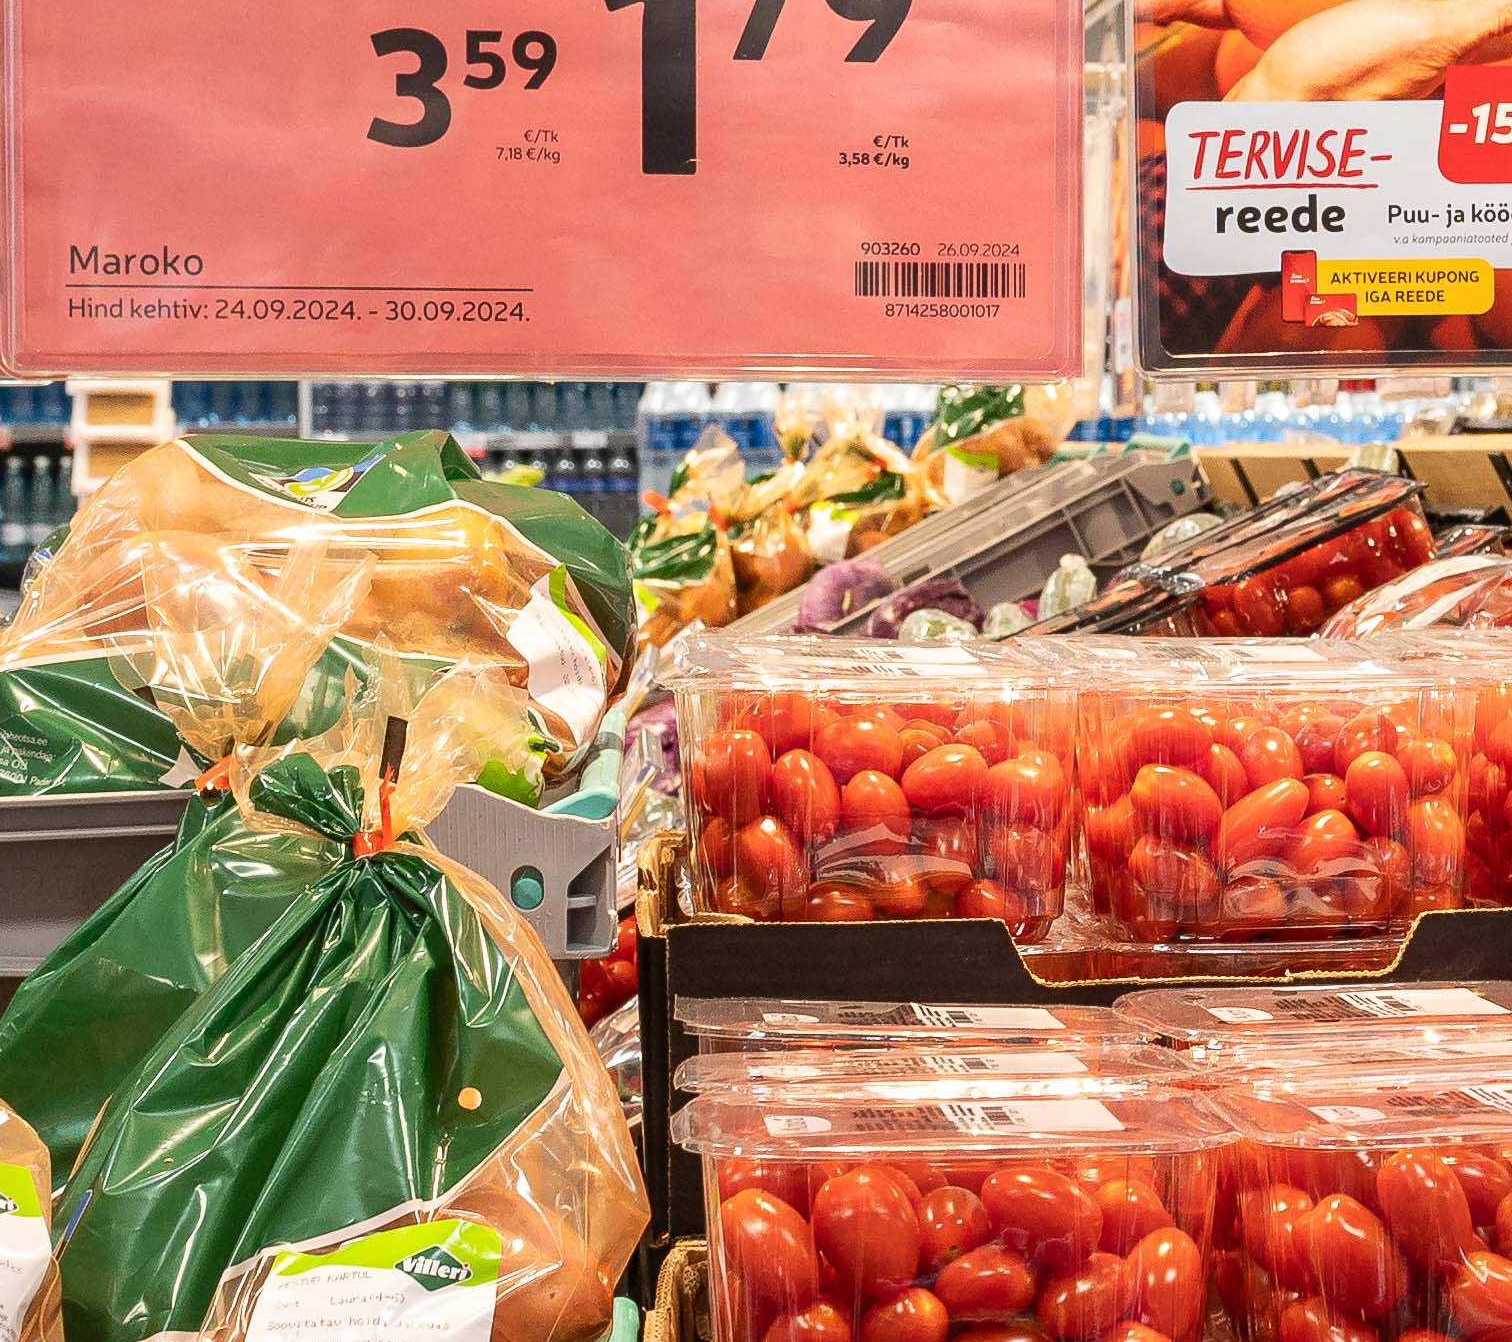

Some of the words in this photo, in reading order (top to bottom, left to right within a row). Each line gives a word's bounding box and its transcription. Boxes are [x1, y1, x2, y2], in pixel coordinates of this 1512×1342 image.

[1188, 128, 1393, 180] TERVISE-
[1216, 193, 1346, 234] reede
[1446, 203, 1465, 229] ja
[69, 244, 204, 276] Maroko
[215, 298, 362, 321] 24.09.2024.
[385, 300, 531, 322] 30.09.2024.
[402, 1255, 471, 1282] Villeri
